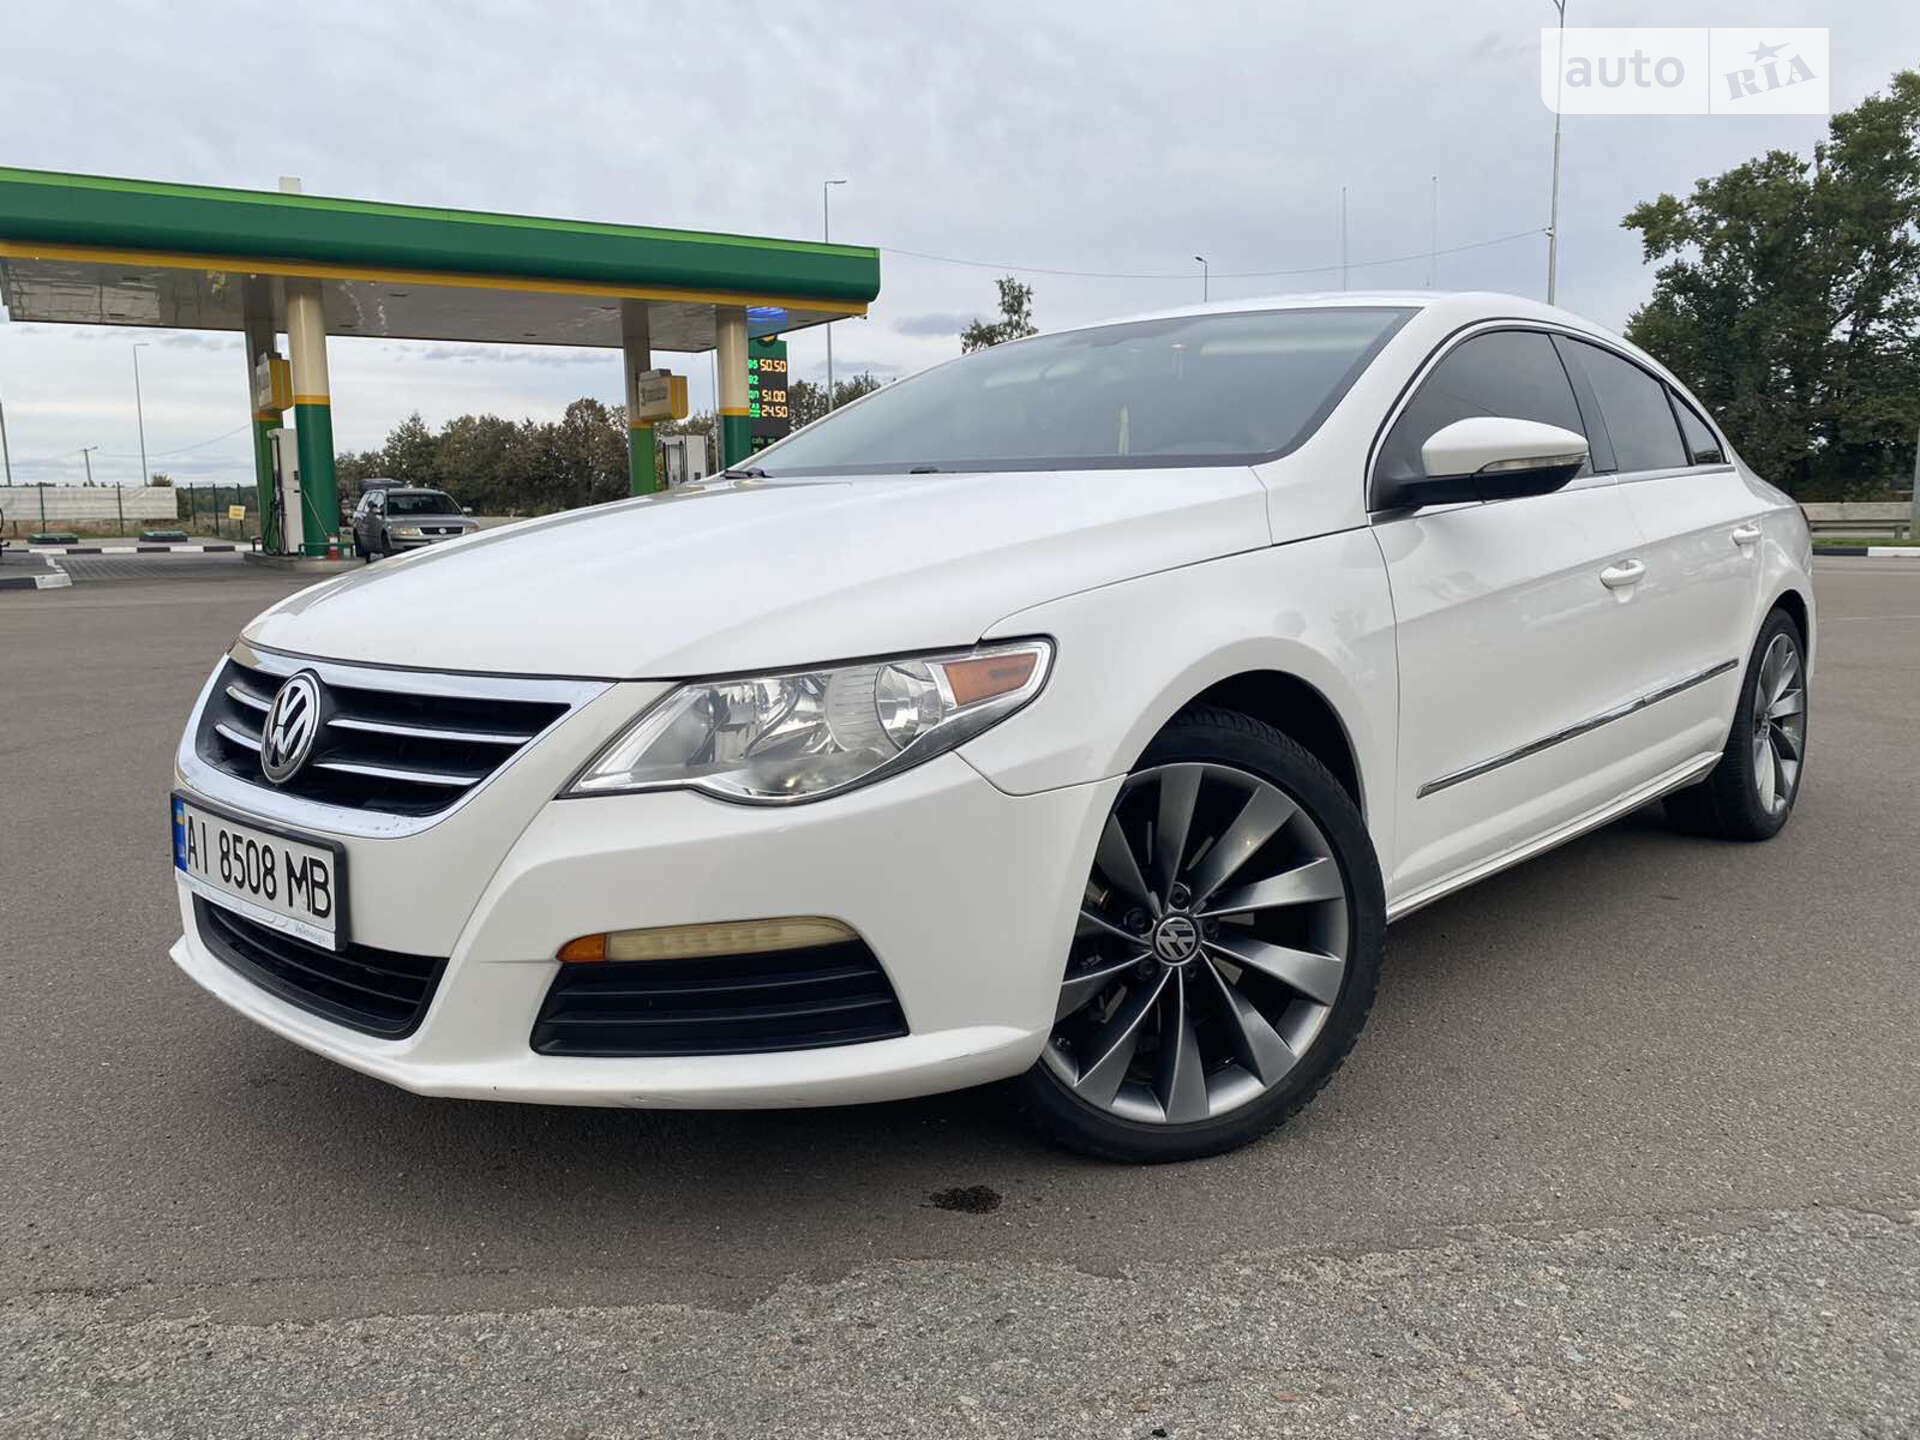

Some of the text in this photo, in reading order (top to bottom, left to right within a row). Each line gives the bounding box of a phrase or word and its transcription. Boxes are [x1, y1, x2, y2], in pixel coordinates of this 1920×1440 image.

[760, 358, 786, 373] 50.50
[762, 389, 786, 403] 51.00
[761, 404, 788, 418] 24.50
[187, 816, 332, 918] AI 8508 MB
